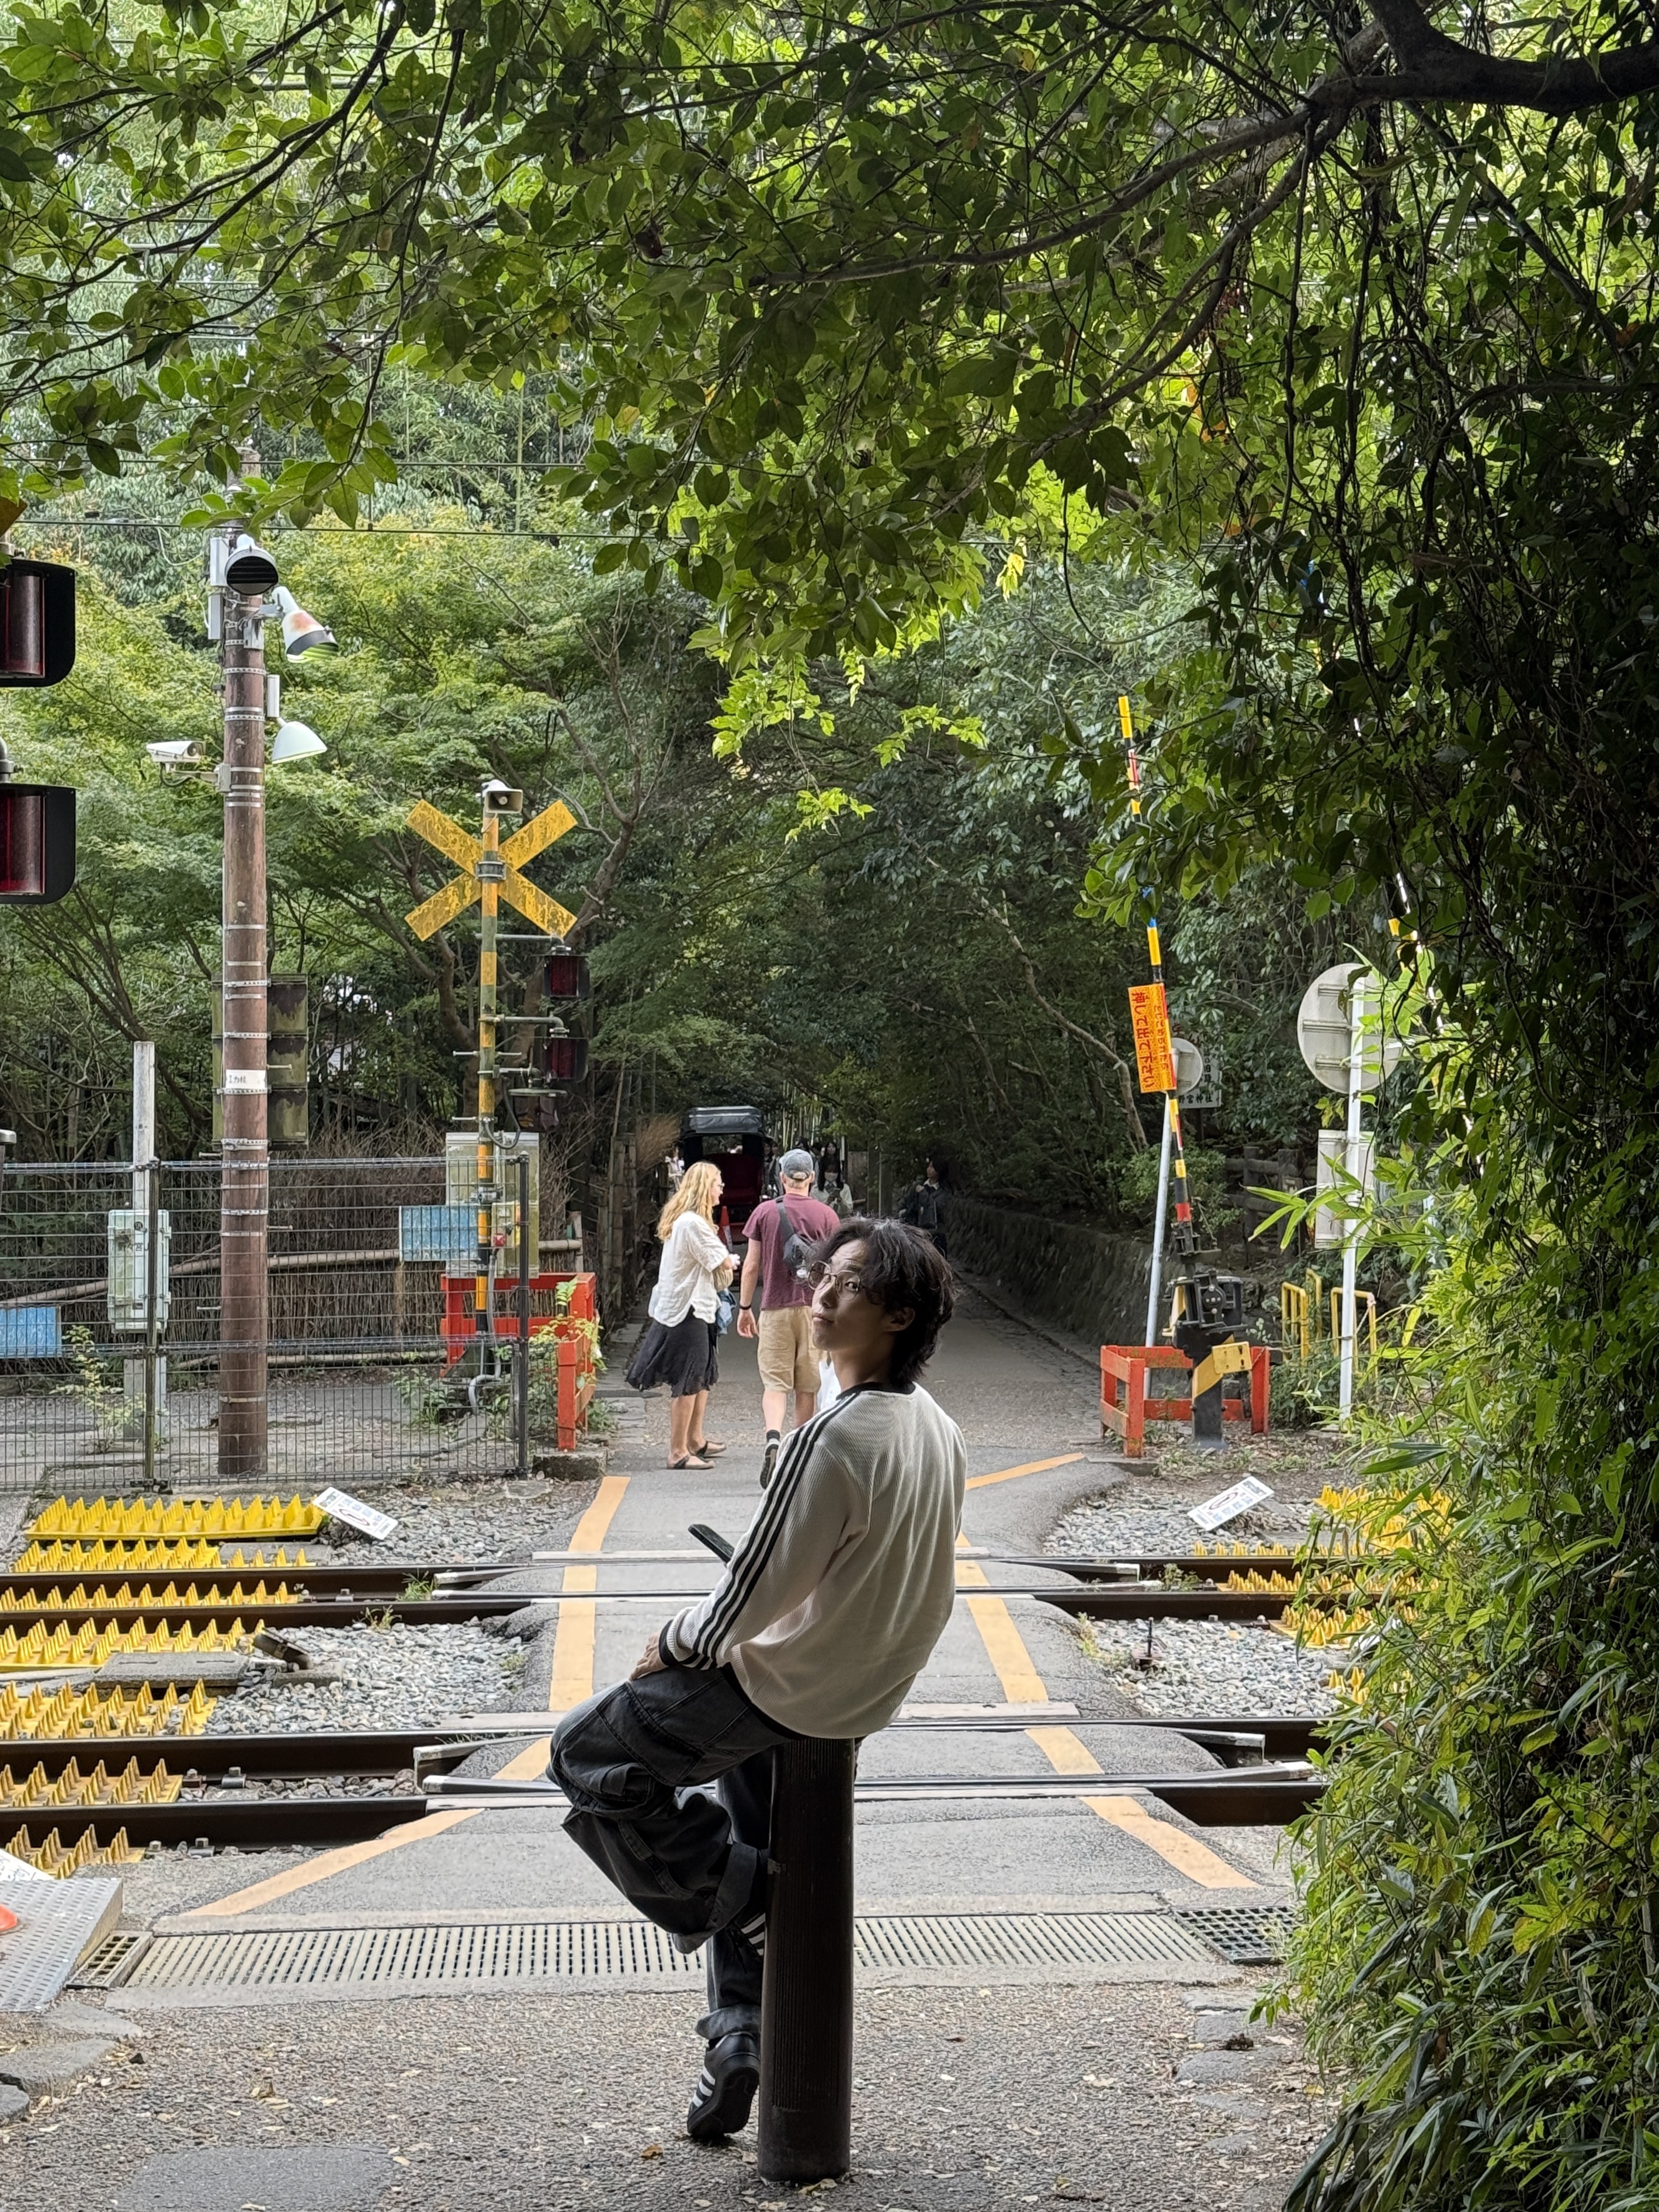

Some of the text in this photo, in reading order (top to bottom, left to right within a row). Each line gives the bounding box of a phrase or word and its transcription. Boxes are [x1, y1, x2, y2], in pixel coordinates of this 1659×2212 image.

[1132, 992, 1155, 1088] 押して出て下さい
[1154, 1005, 1168, 1069] とじこめられたら
